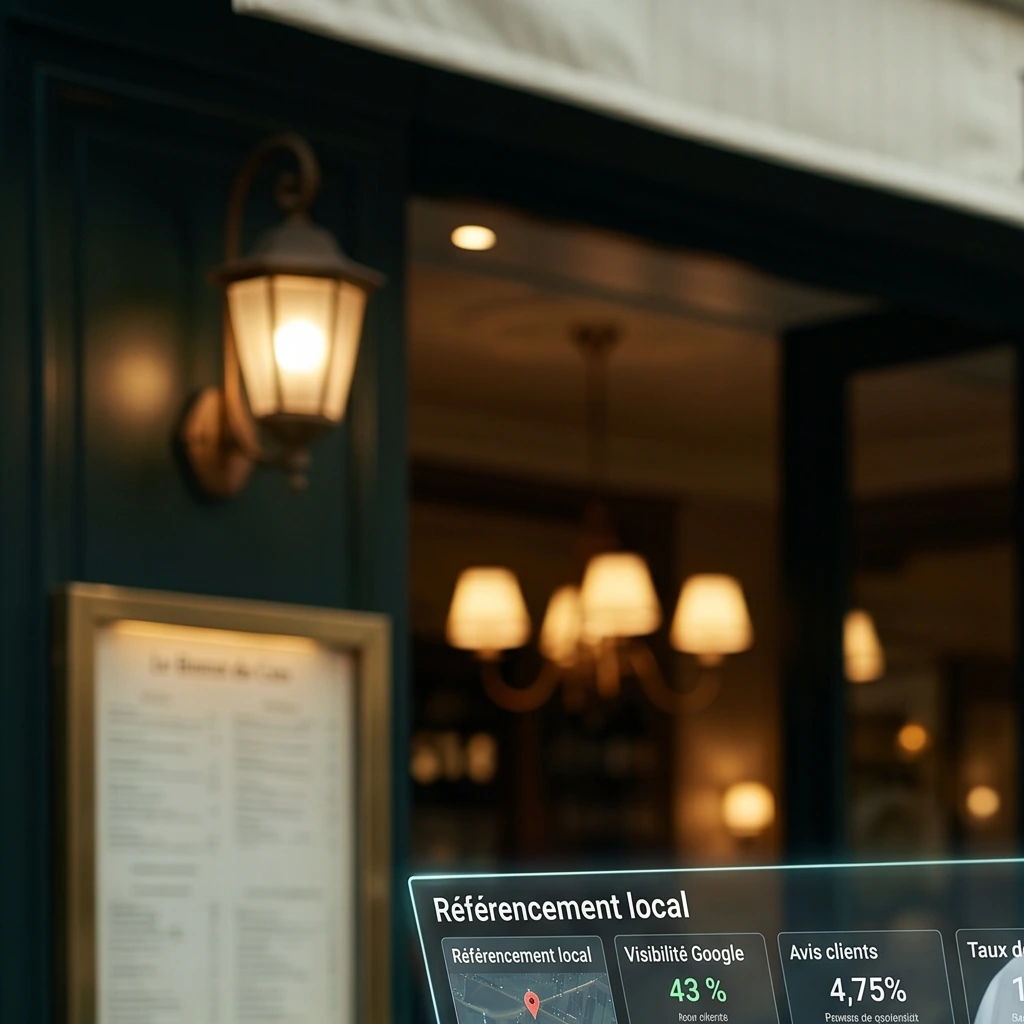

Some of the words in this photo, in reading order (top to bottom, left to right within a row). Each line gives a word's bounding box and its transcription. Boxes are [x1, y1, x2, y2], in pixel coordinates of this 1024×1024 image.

[433, 894, 623, 923] Référencement
[627, 890, 691, 919] local
[558, 946, 592, 963] local
[624, 946, 689, 963] Visibilité
[691, 945, 745, 966] Google
[790, 943, 822, 960] Avis
[825, 942, 878, 959] clients
[967, 941, 1009, 959] Taux
[669, 977, 700, 1002] 43
[705, 977, 727, 1002] %
[829, 976, 907, 1007] 4,75%
